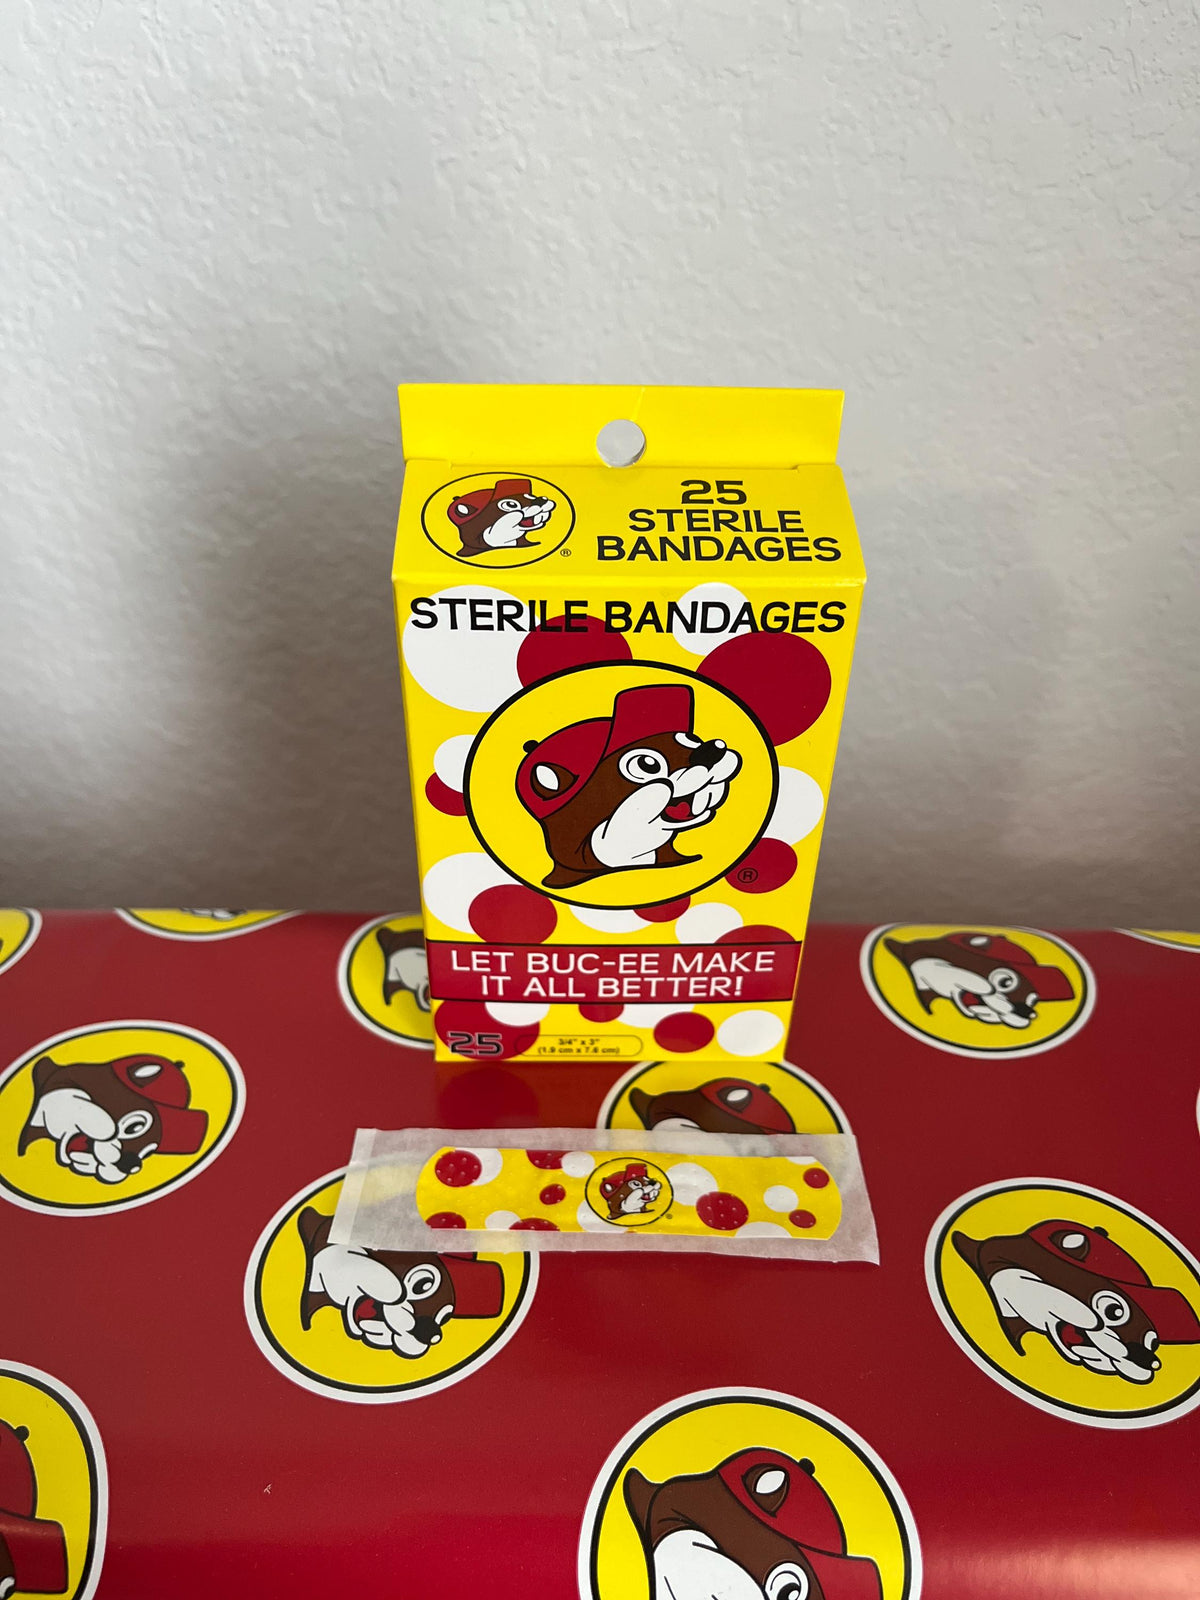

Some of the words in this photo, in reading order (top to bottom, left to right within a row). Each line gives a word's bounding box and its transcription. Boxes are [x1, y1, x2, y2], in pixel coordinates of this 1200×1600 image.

[681, 480, 747, 505] 25
[628, 509, 805, 533] STERILE
[597, 536, 842, 561] BANDAGES
[410, 597, 588, 632] STERILE
[604, 601, 847, 634] BANDAGES
[451, 950, 514, 973] LET
[527, 953, 660, 974] BUC-EE
[672, 951, 775, 974] MAKE
[481, 975, 511, 996] IT
[523, 977, 586, 997] ALL
[598, 976, 743, 997] BETTER!
[447, 1031, 503, 1056] 25
[538, 1046, 556, 1055] (1.9
[601, 1046, 620, 1055] cm)
